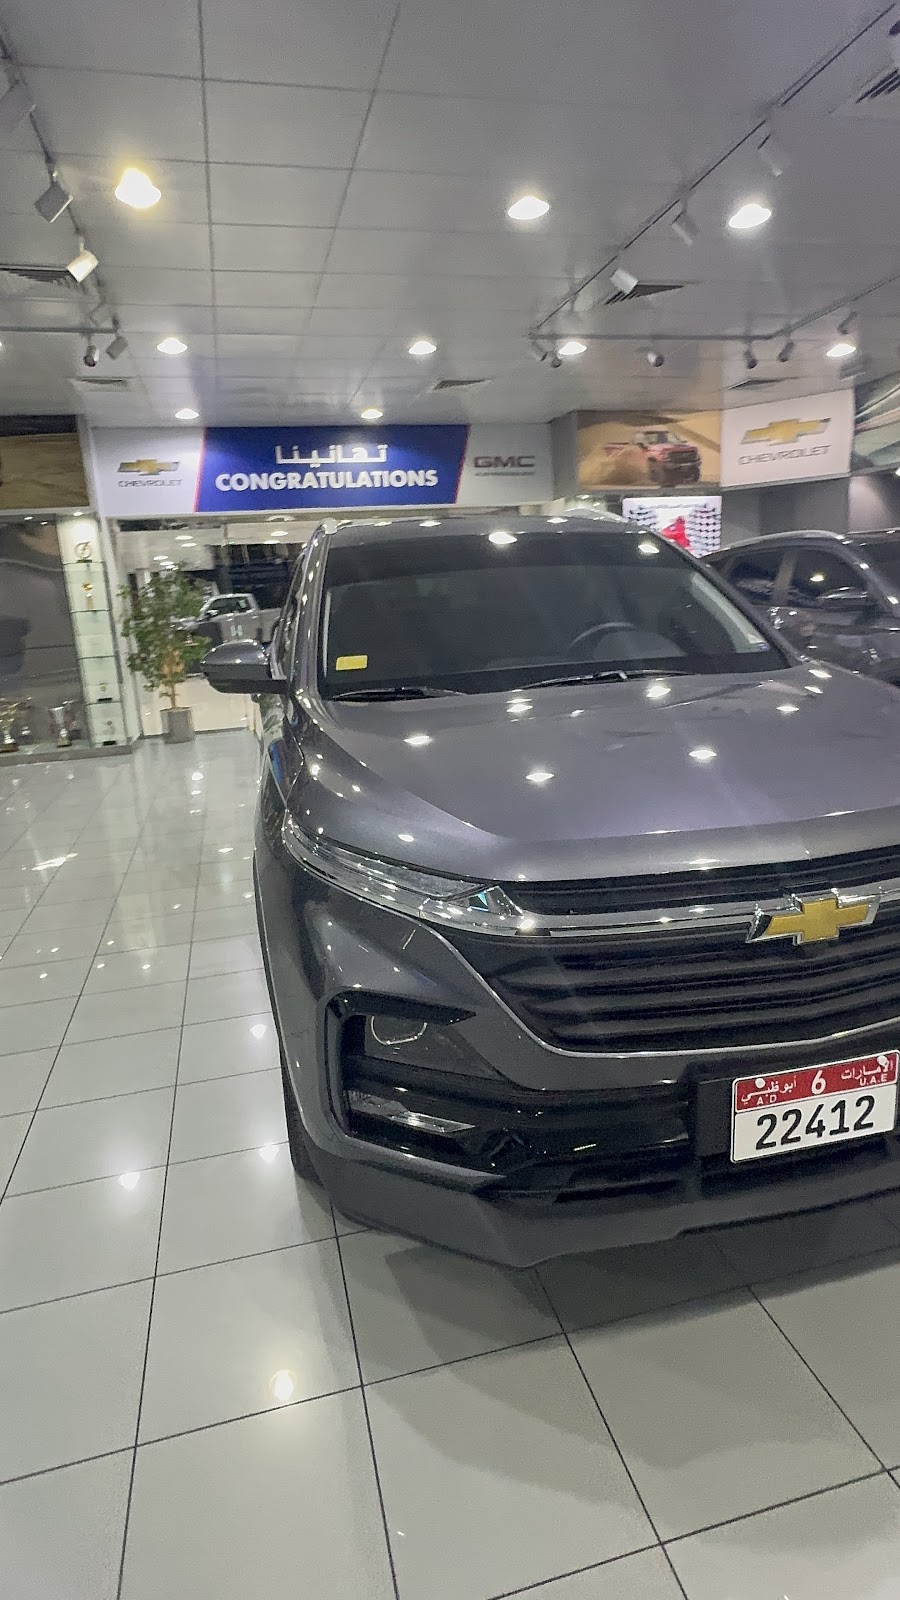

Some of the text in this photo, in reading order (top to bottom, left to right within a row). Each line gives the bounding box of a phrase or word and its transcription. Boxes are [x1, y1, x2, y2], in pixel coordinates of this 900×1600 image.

[474, 455, 536, 468] GMC
[738, 444, 831, 466] CHEVROLET
[118, 479, 183, 487] CHEVROLET
[215, 469, 439, 492] CONGRATULATIONS
[811, 1070, 826, 1095] 6
[755, 1095, 875, 1150] 22412
